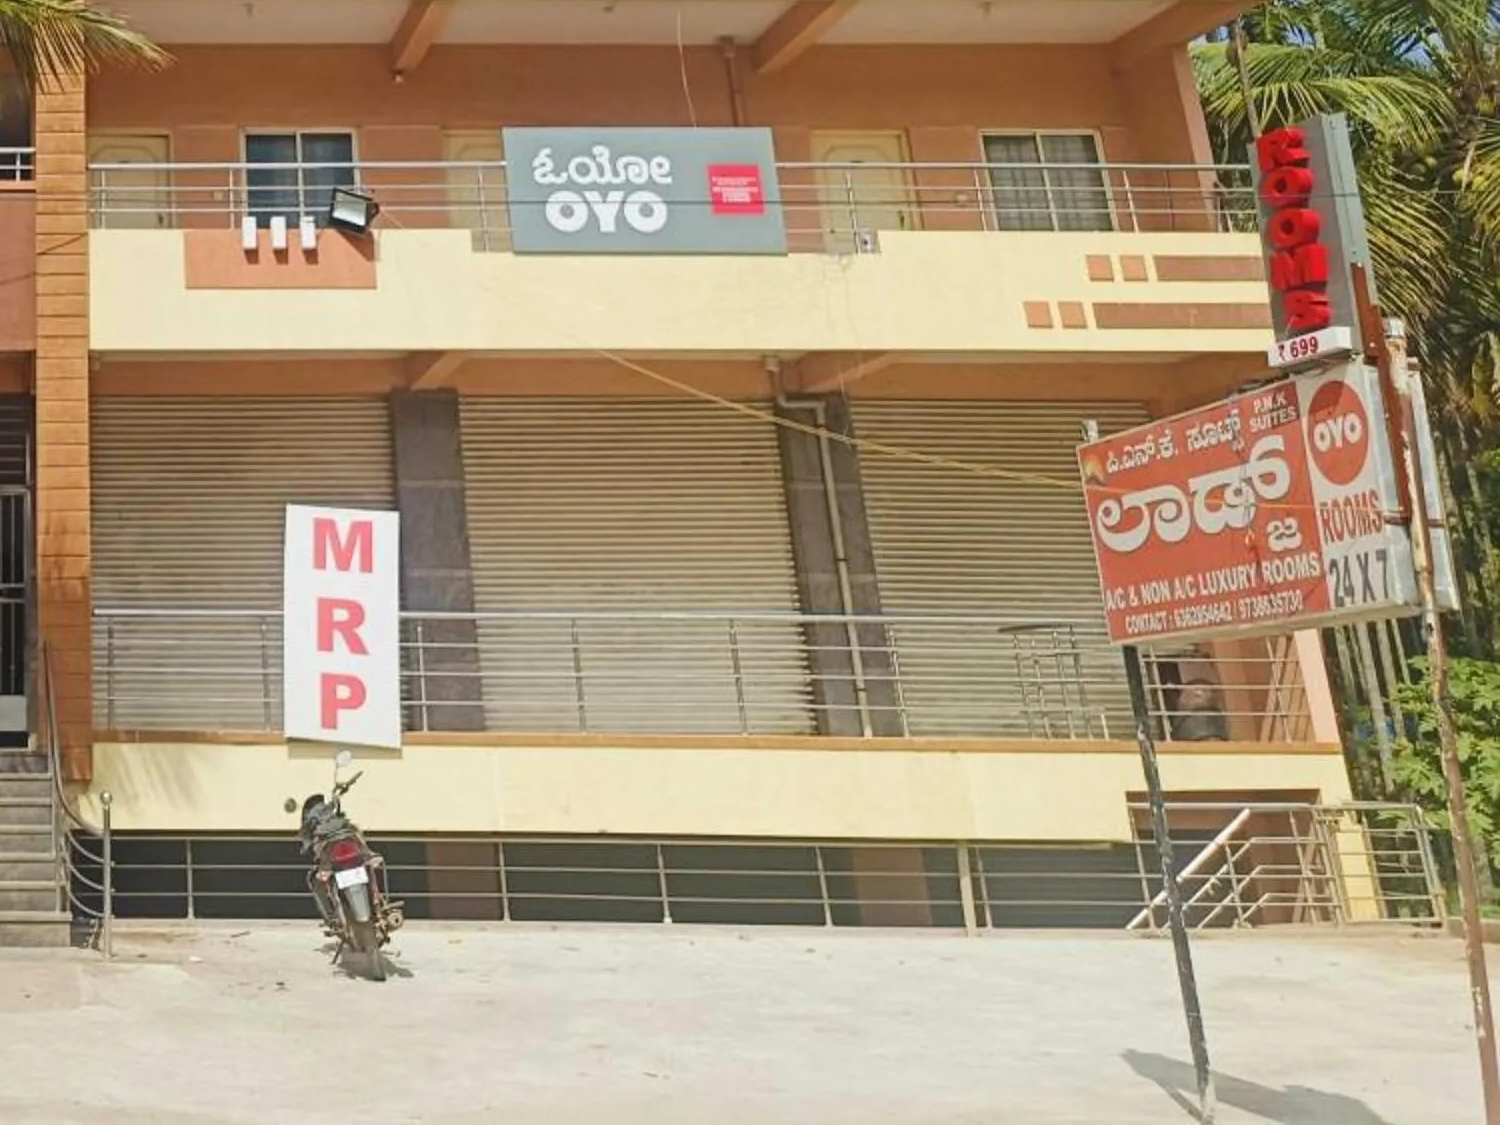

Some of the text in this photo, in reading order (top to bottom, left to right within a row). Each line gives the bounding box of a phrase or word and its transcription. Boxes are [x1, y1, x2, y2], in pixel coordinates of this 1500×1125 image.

[545, 190, 668, 233] OYO
[1256, 127, 1332, 331] ROOMS
[1289, 335, 1319, 359] 699
[1249, 406, 1297, 432] SUITES
[1313, 411, 1362, 452] OYO
[1319, 489, 1383, 546] ROOMS
[1141, 580, 1171, 606] NON
[1198, 561, 1257, 597] LUXURY
[1261, 551, 1321, 585] ROOMS
[312, 517, 374, 730] MRP
